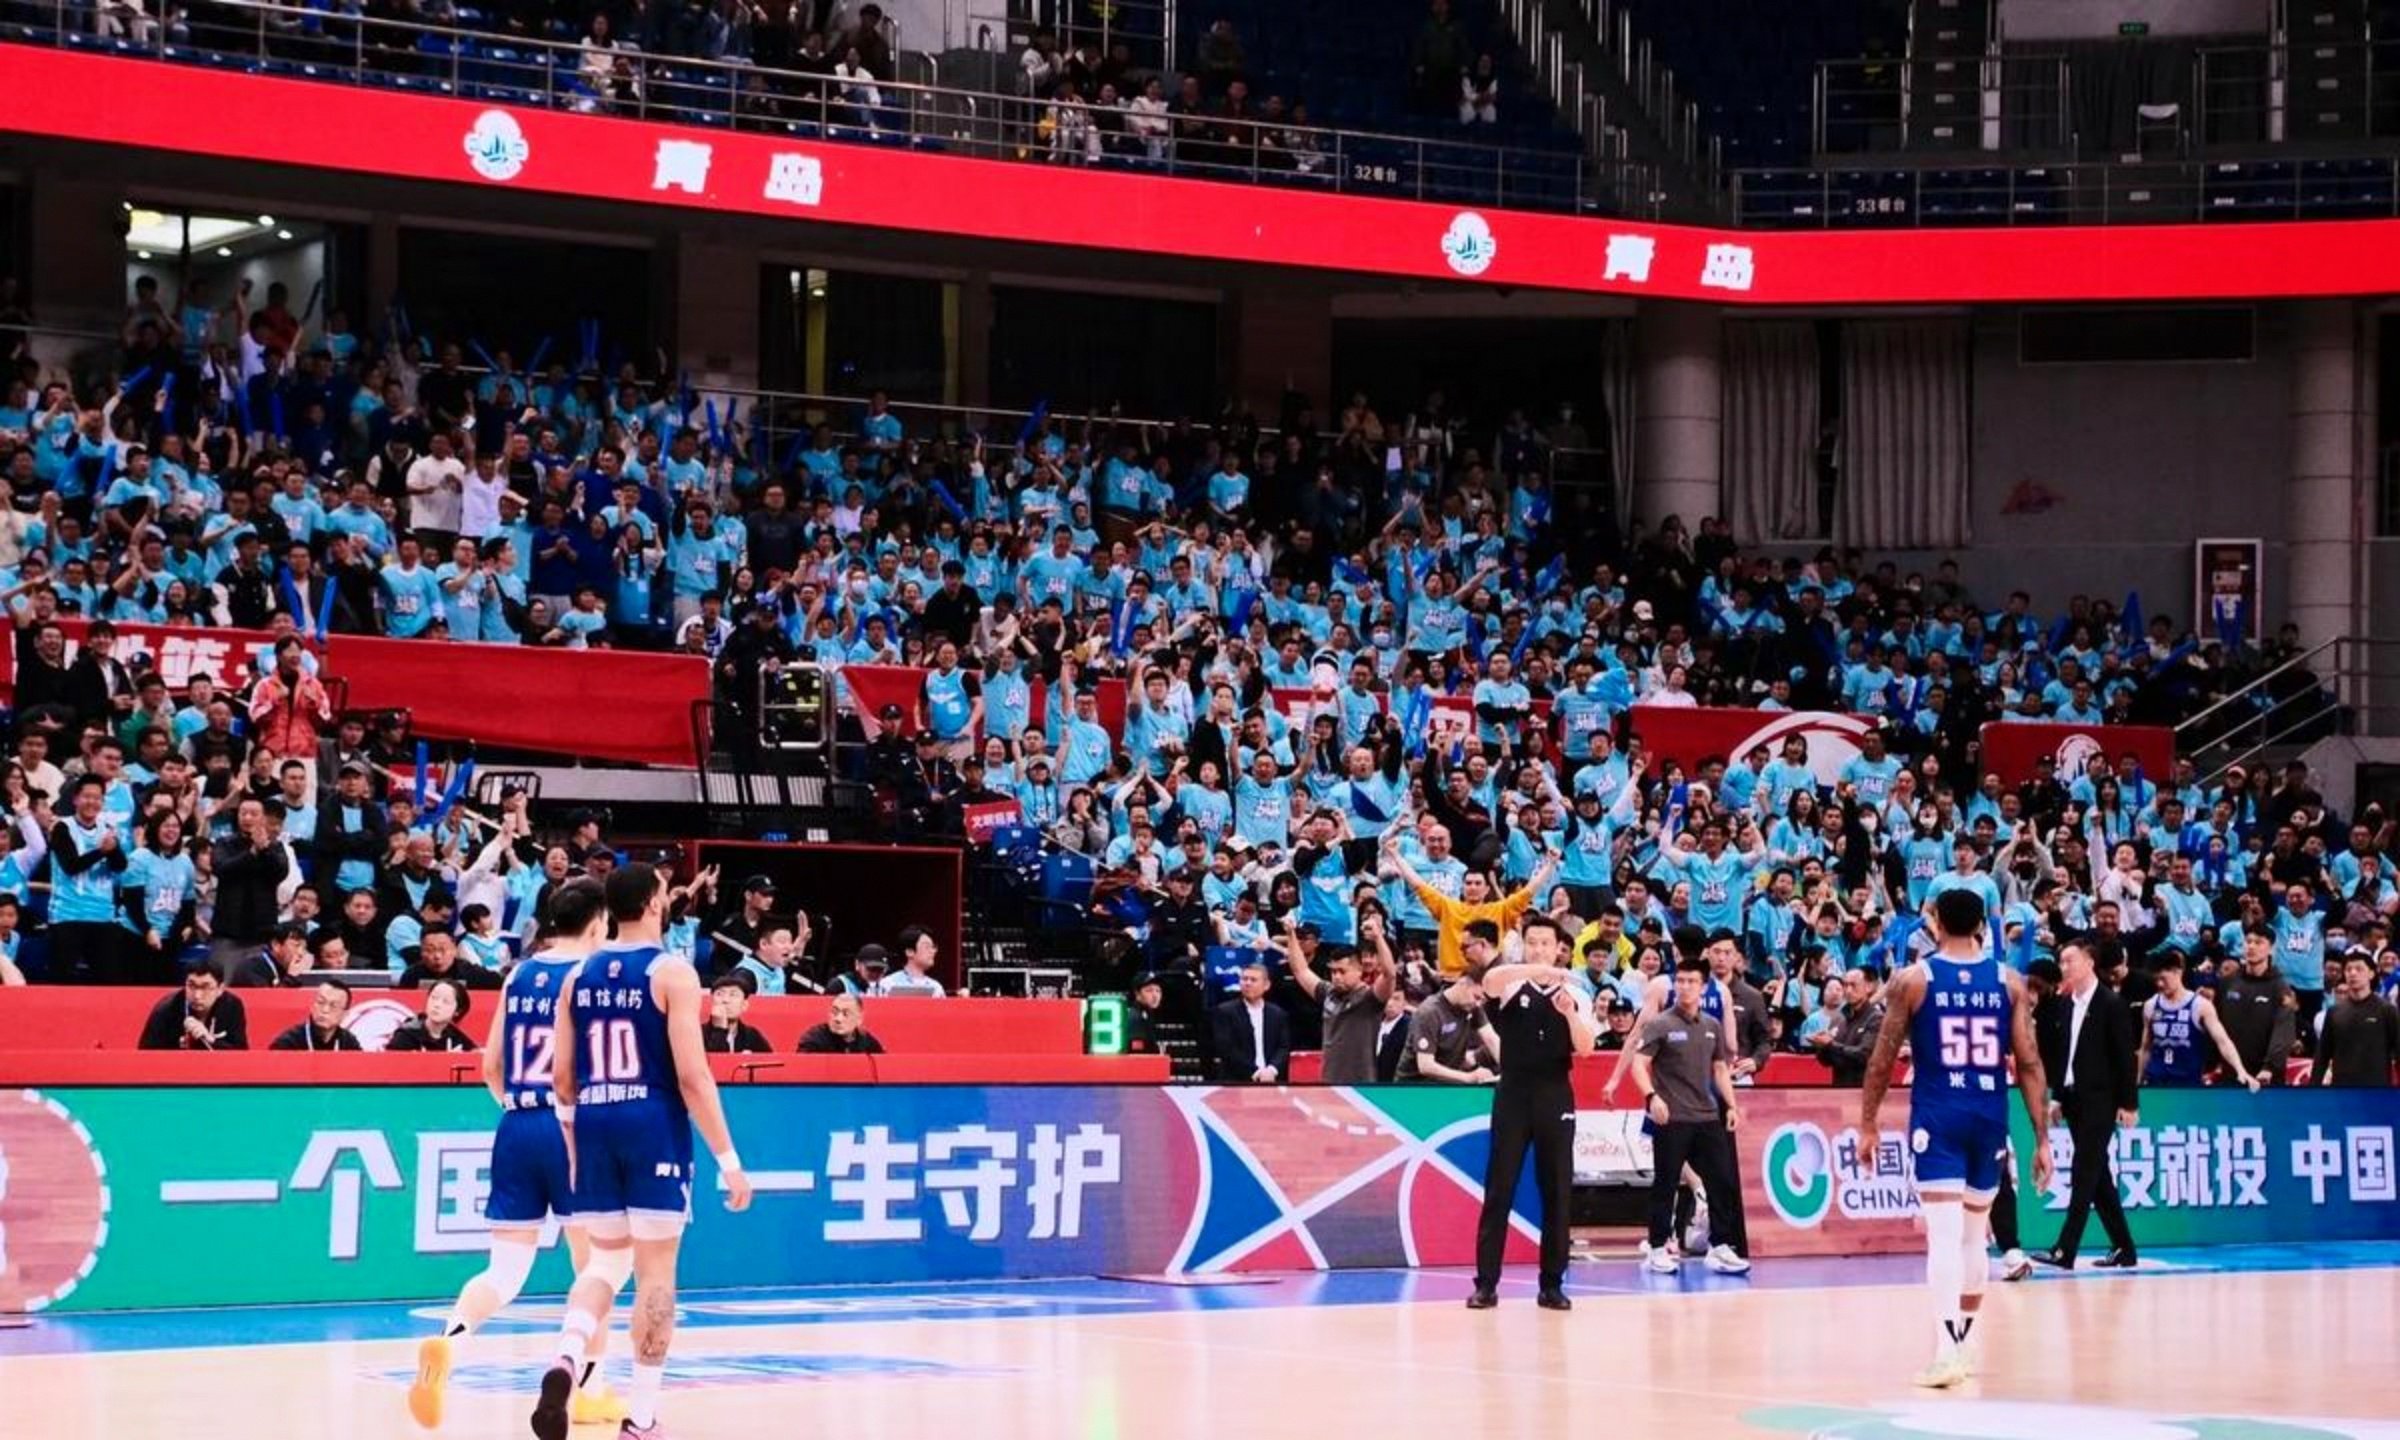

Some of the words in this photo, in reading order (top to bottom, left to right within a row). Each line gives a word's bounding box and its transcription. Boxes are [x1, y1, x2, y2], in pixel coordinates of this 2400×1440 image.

[510, 1024, 555, 1083] 12
[587, 1019, 641, 1080] 10
[1938, 1015, 1999, 1066] 55
[160, 1130, 562, 1258] 一个国
[716, 1124, 1121, 1241] 一生守护
[2291, 1124, 2397, 1204] 中国
[1844, 1188, 1921, 1211] CHINA
